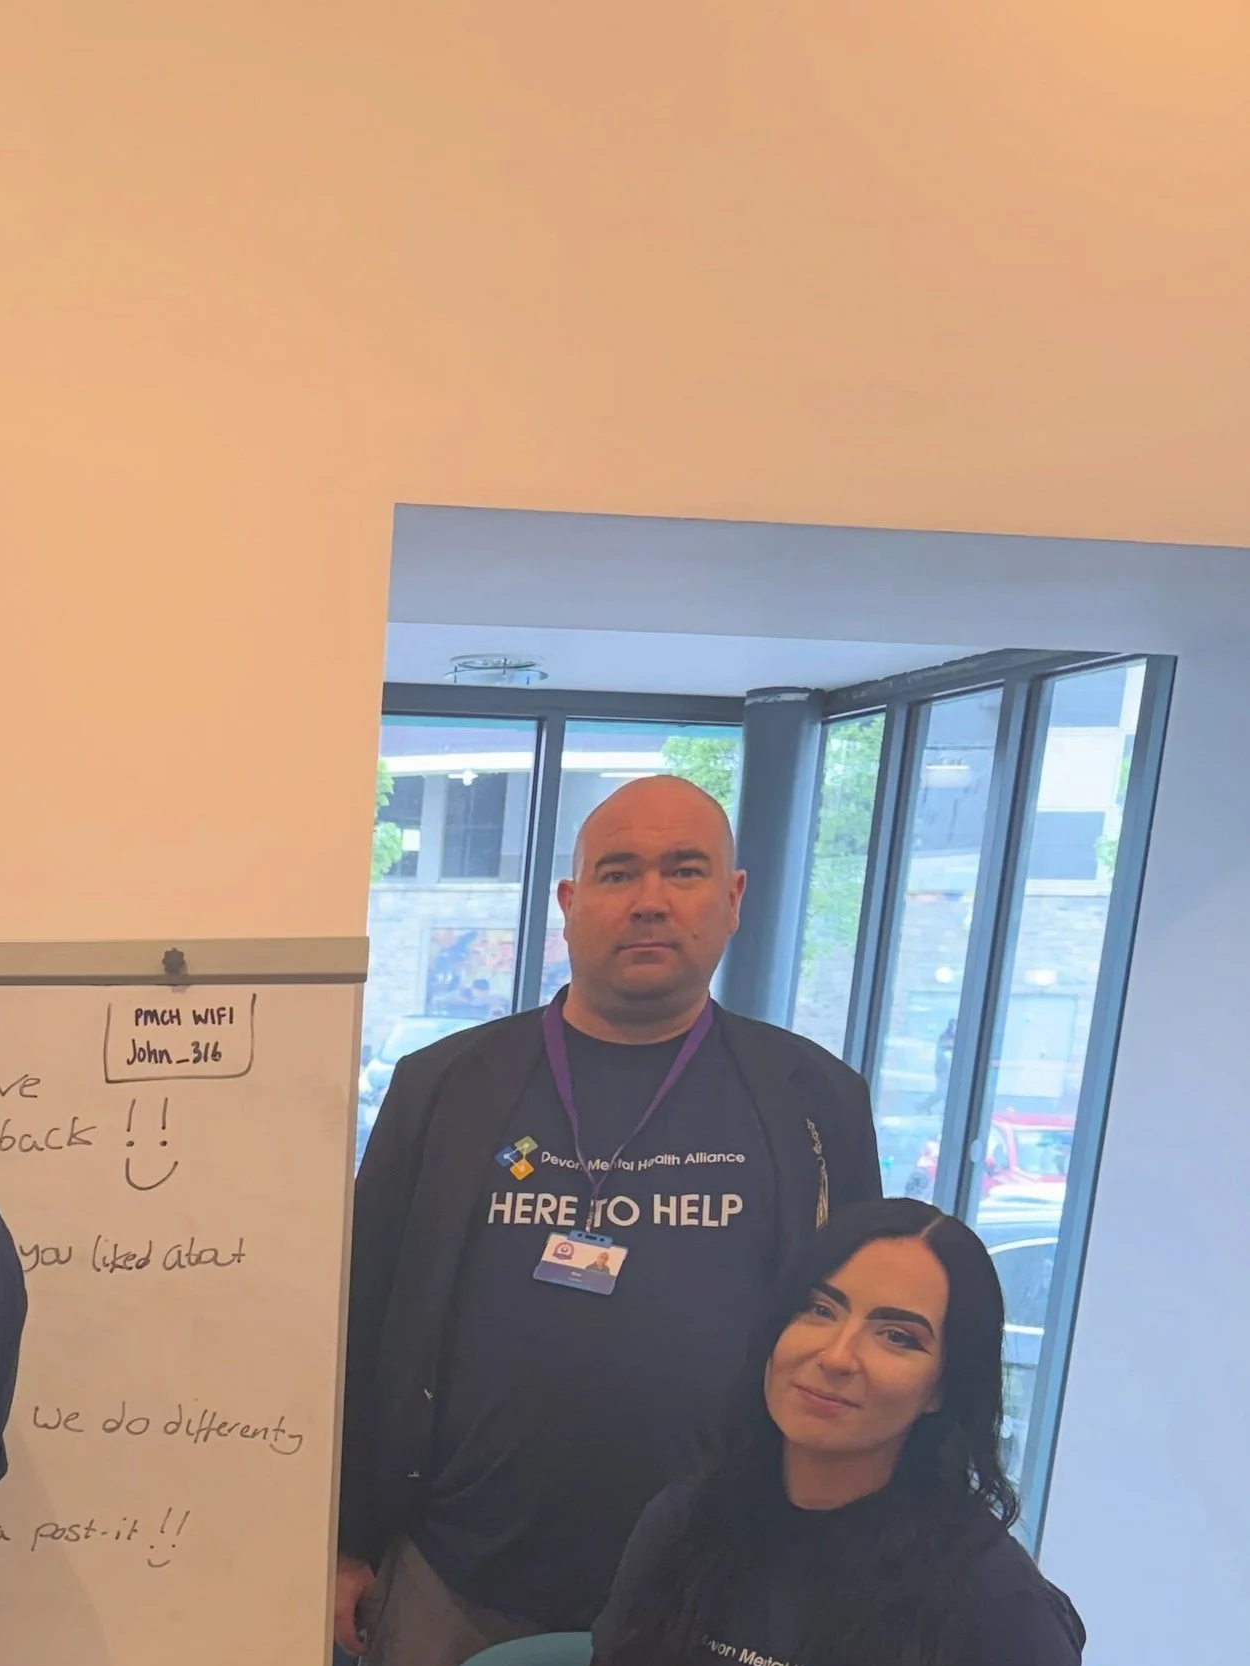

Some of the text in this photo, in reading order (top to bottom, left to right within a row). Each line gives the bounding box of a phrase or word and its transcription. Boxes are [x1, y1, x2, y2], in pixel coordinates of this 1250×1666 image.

[134, 1006, 234, 1027] PMCH WIFI
[126, 1038, 223, 1066] John_316
[685, 1150, 746, 1165] Alliance
[487, 1191, 744, 1228] HERE TO HELP
[18, 1243, 73, 1272] you
[92, 1235, 153, 1273] liked
[101, 1401, 150, 1436] do
[30, 1516, 139, 1552] post-it
[702, 1635, 737, 1658] von
